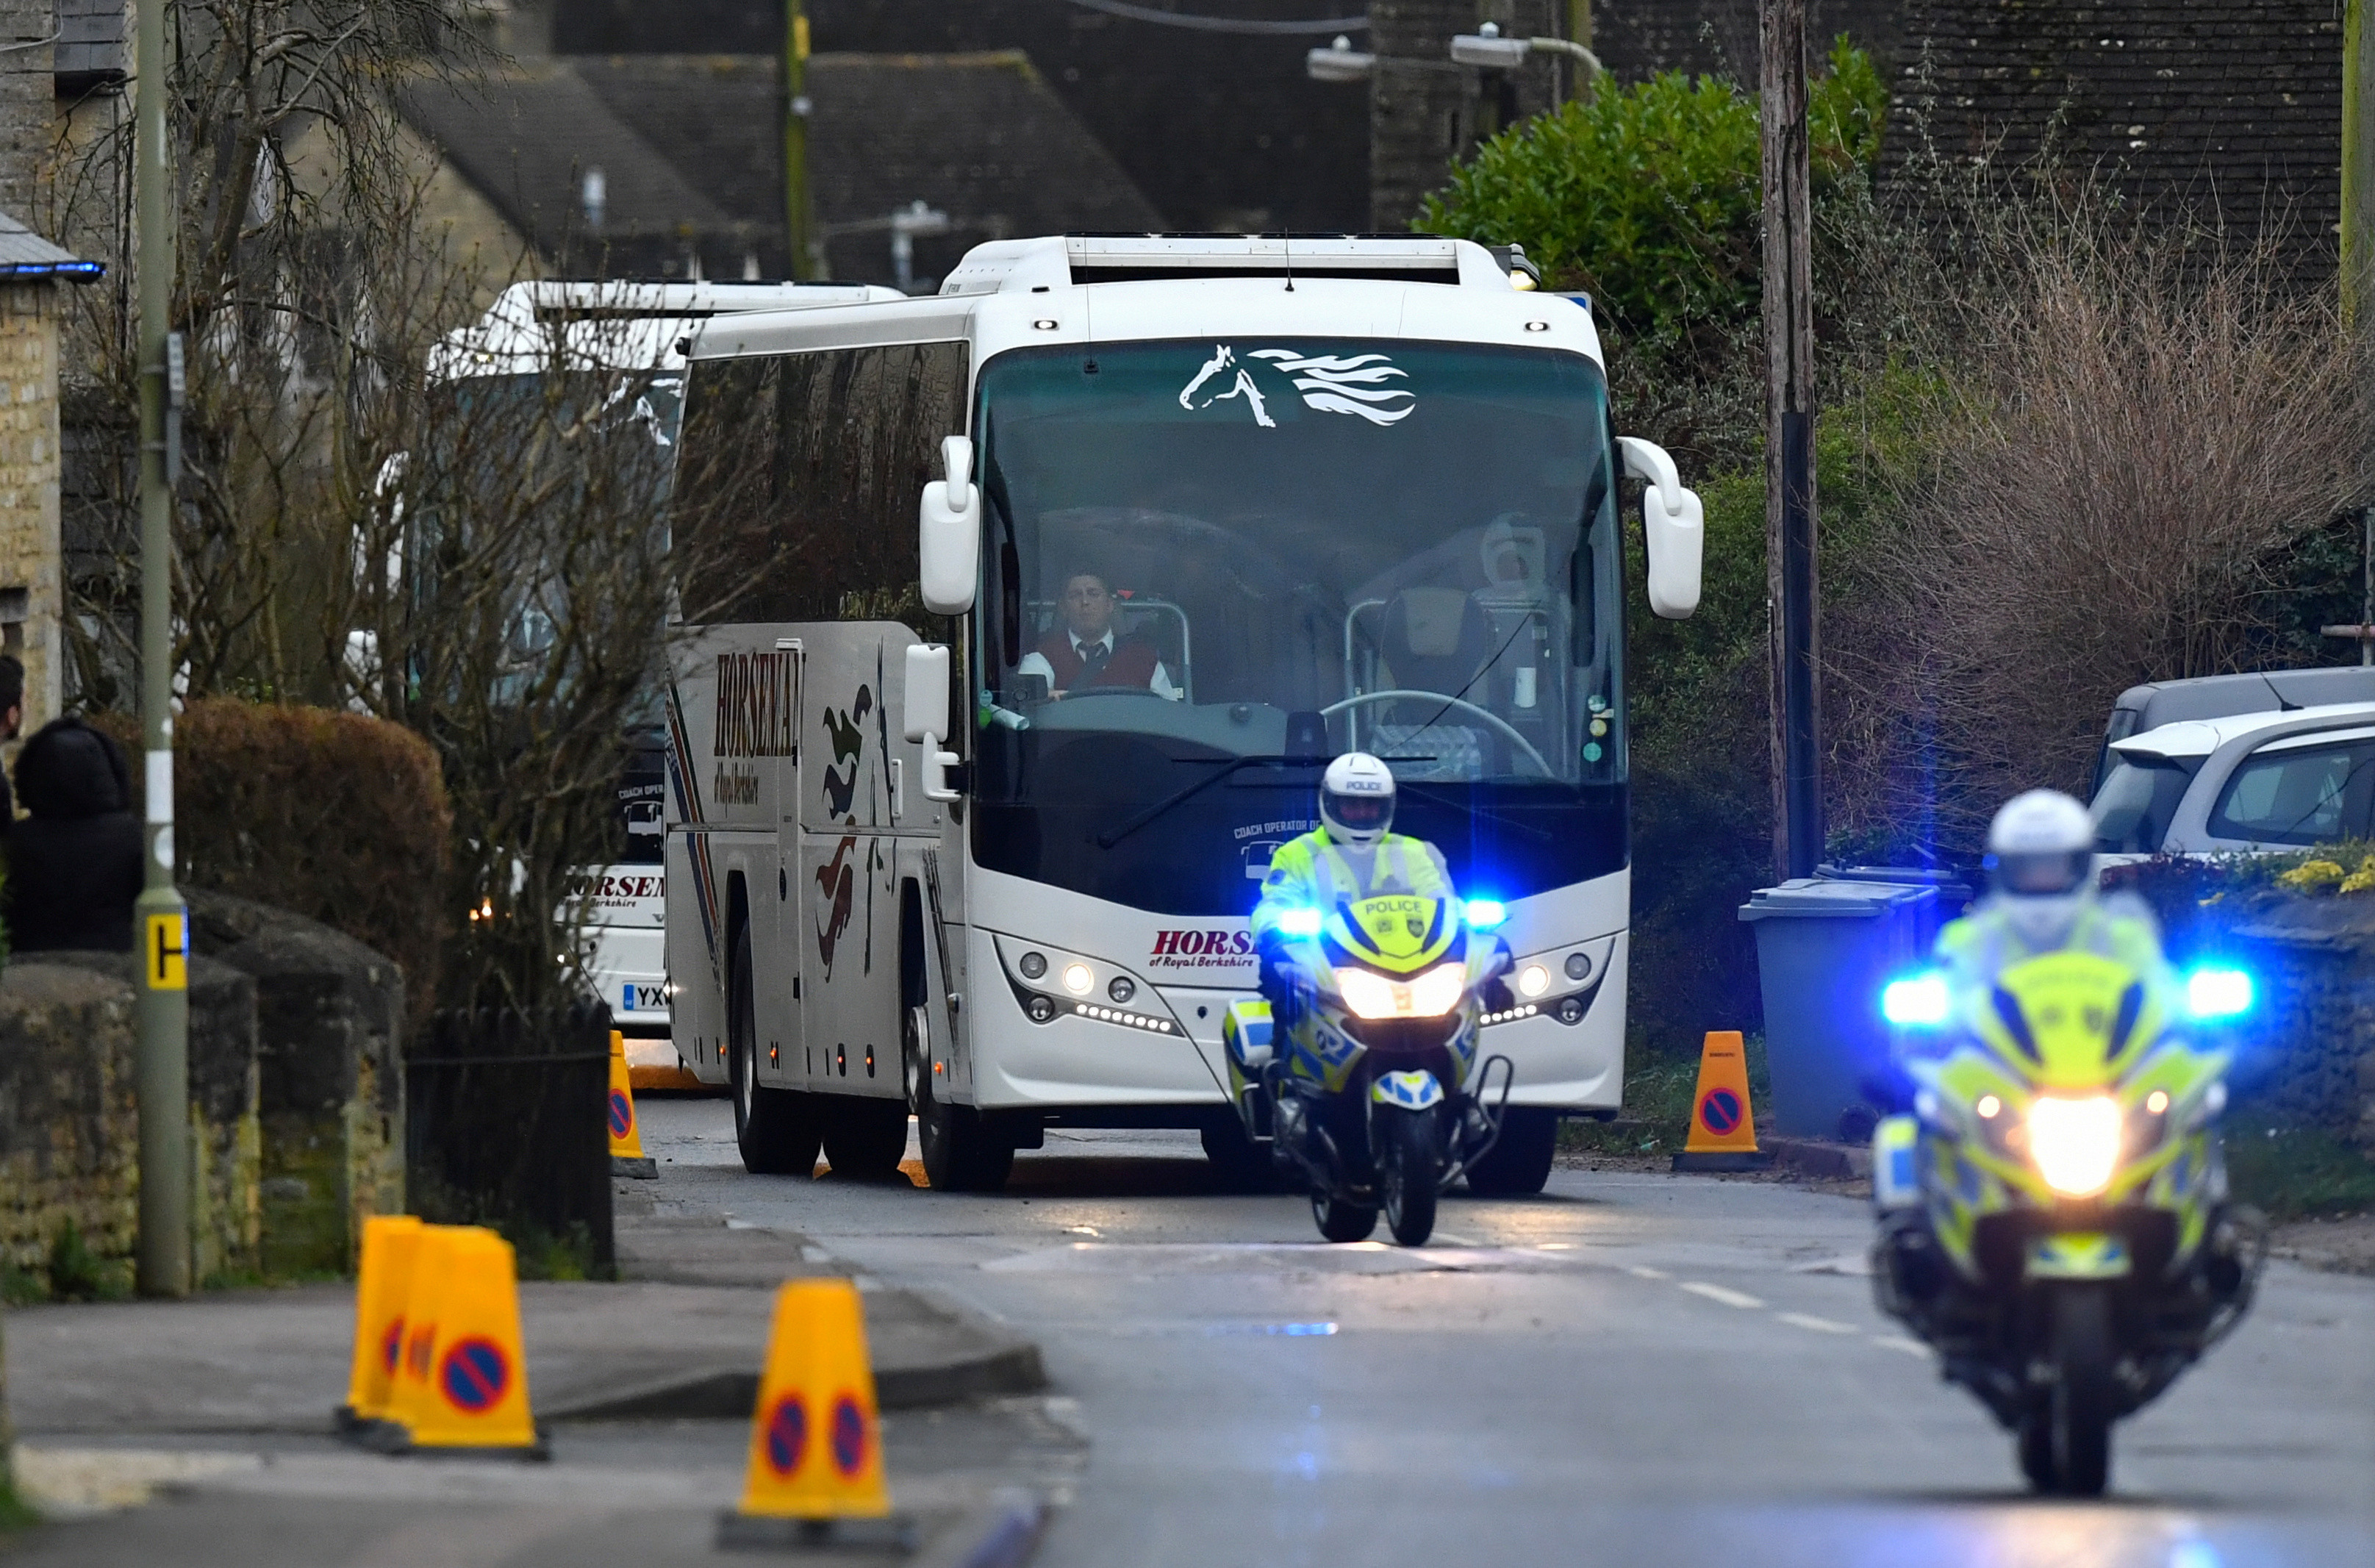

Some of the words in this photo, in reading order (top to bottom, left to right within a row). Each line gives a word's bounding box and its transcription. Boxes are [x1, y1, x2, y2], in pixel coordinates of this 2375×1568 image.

[1346, 781, 1382, 791] POLICE
[1233, 823, 1263, 840] COACH
[1264, 820, 1307, 834] OPERATOR
[1365, 901, 1422, 914] POLICE
[1149, 956, 1162, 967] of
[1163, 956, 1196, 970] Royal
[1197, 956, 1254, 967] Berkshire
